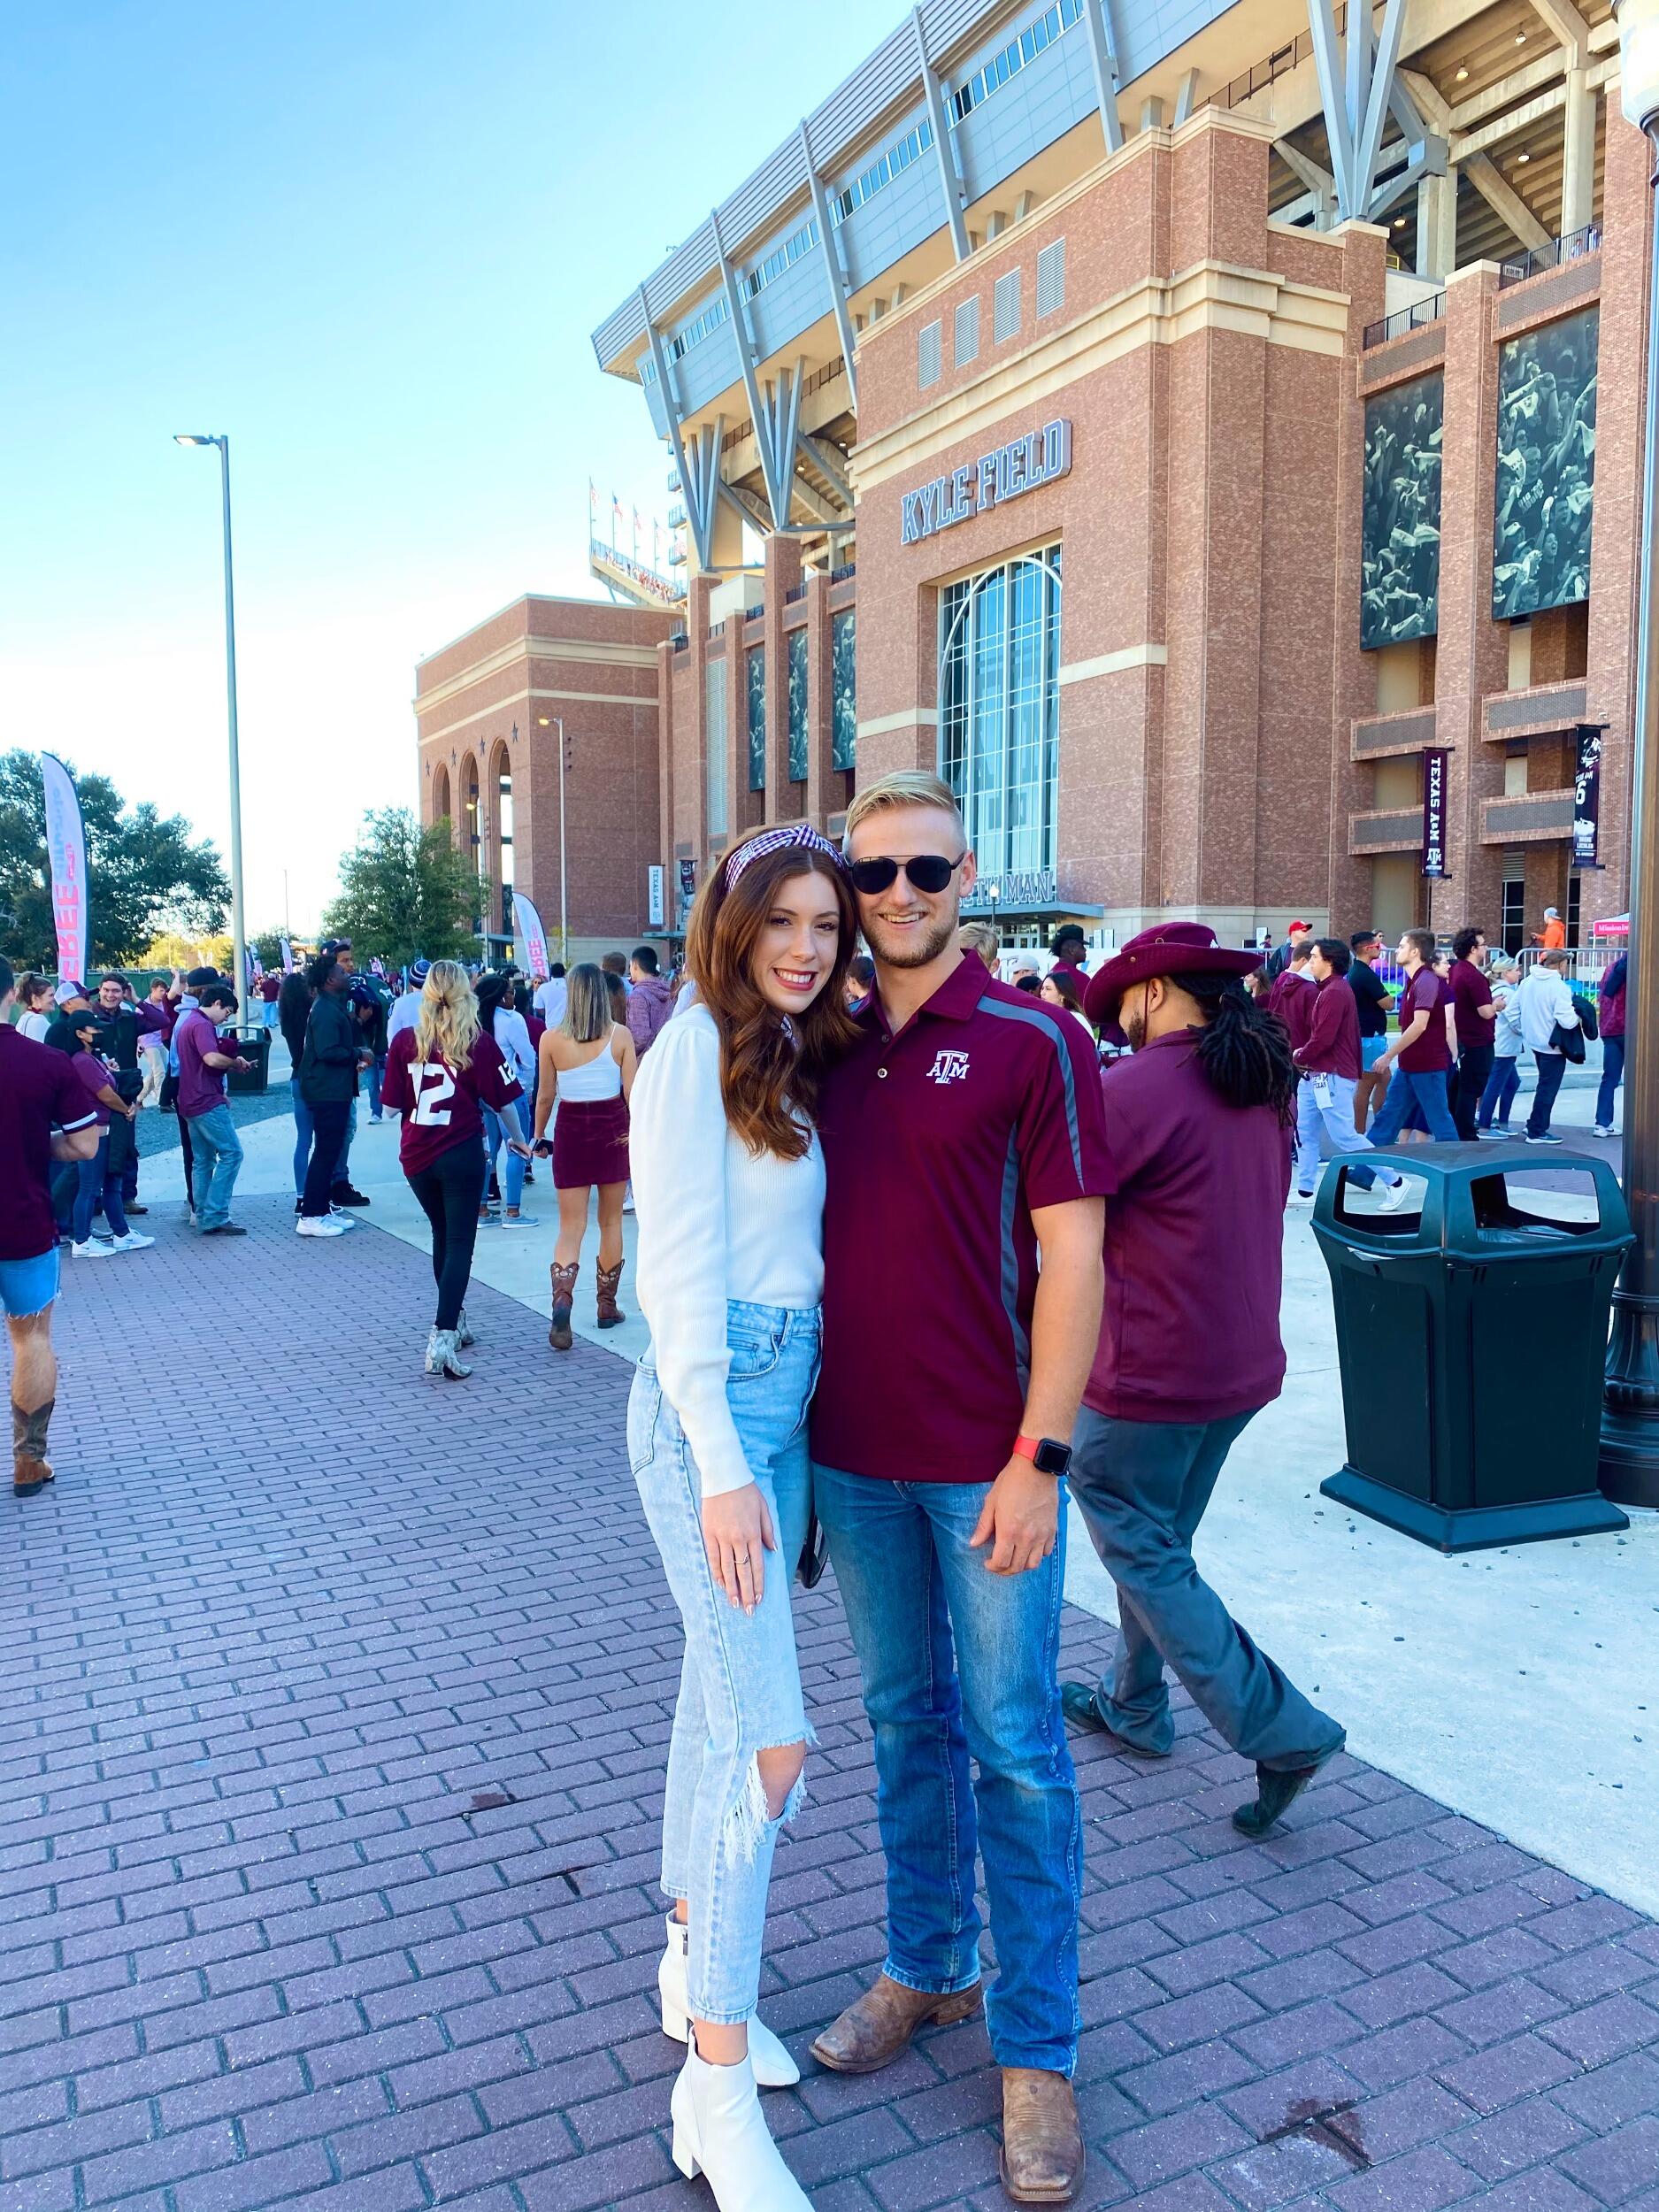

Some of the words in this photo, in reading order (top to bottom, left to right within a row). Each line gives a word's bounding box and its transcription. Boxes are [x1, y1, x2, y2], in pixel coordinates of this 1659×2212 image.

[901, 464, 974, 546] KYLE
[976, 418, 1071, 512] FIELD
[1430, 757, 1441, 808] TEXAS
[1575, 780, 1586, 805] 6
[1429, 812, 1440, 841] A&M
[1005, 871, 1050, 904] MAN
[407, 1063, 457, 1125] 12
